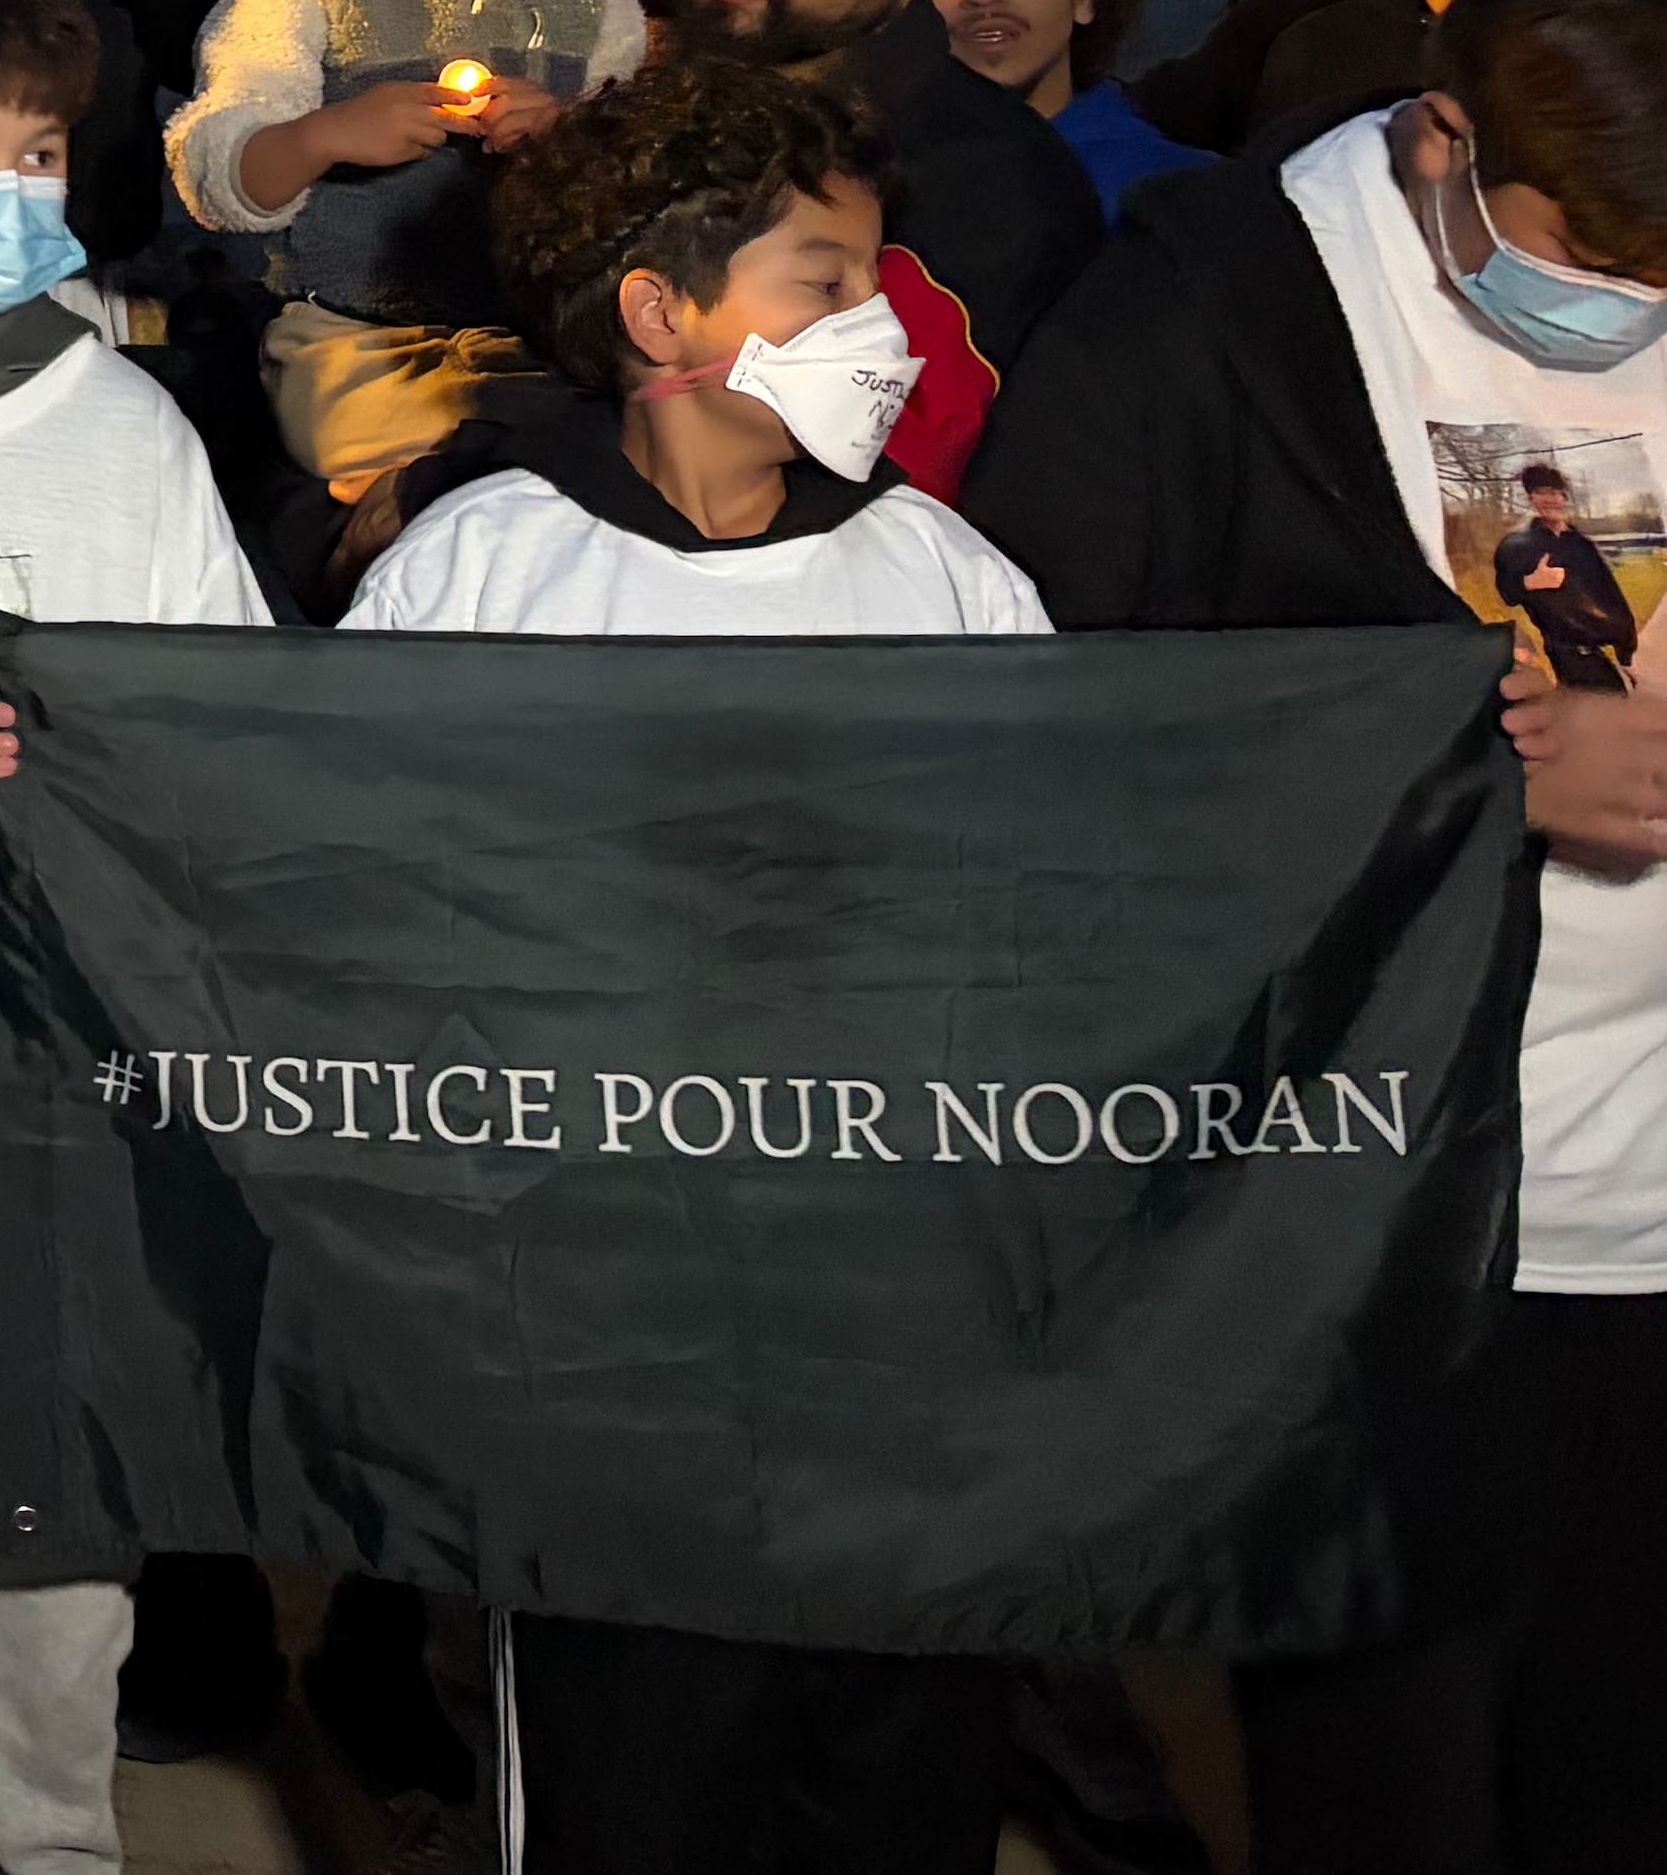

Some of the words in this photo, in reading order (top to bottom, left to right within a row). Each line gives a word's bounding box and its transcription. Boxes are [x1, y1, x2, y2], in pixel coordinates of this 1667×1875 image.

[93, 1049, 562, 1152] #JUSTICE
[593, 1071, 903, 1164] POUR
[924, 1068, 1412, 1167] NOORAN
